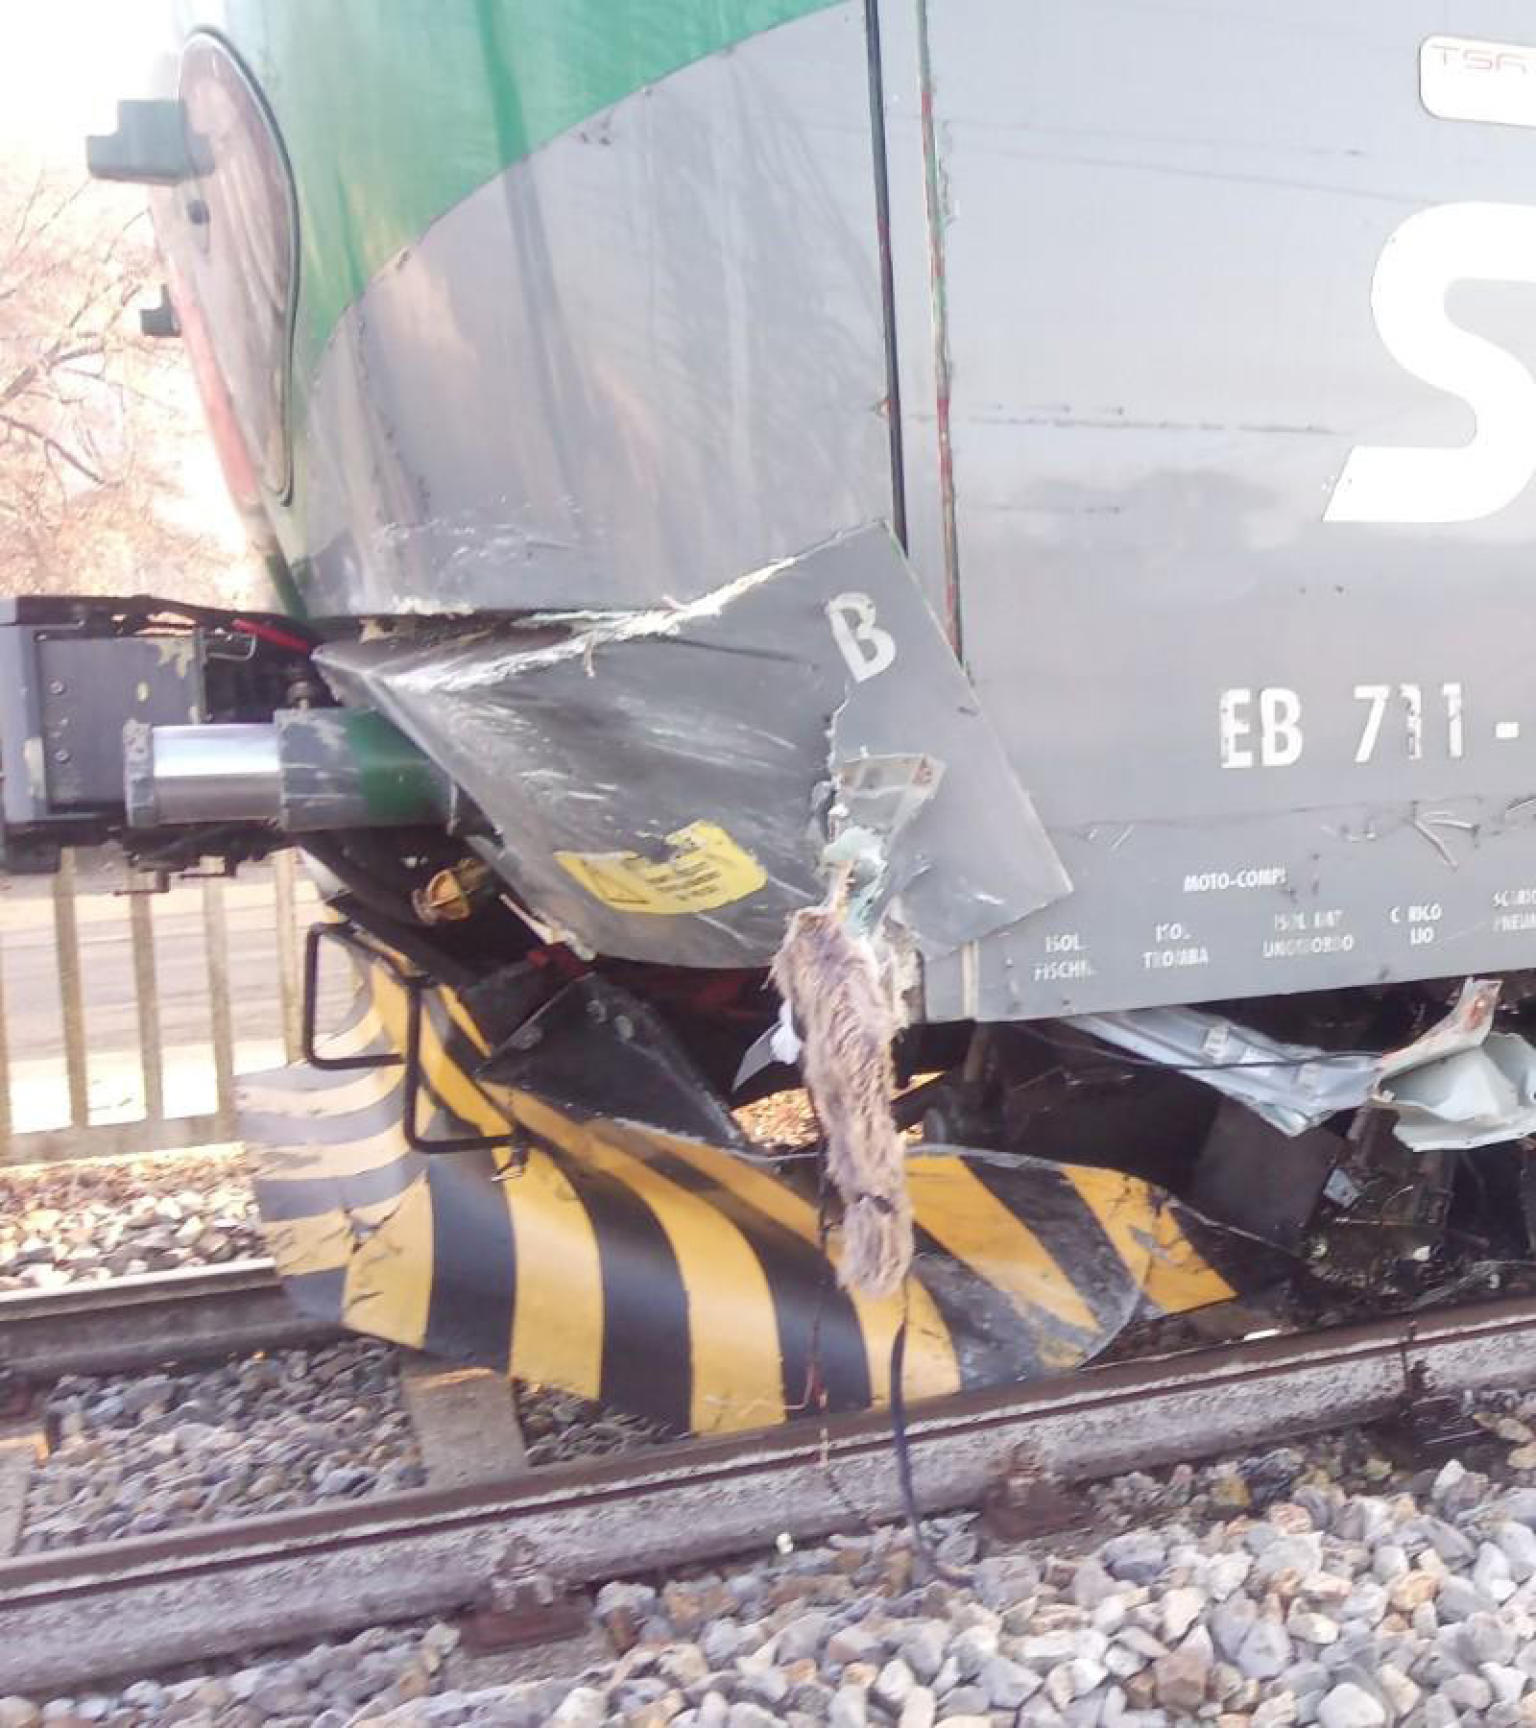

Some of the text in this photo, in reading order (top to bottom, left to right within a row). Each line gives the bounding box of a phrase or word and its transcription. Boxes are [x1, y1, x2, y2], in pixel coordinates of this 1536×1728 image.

[825, 591, 896, 683] B
[1219, 686, 1304, 769] EB
[1352, 681, 1464, 763] 711
